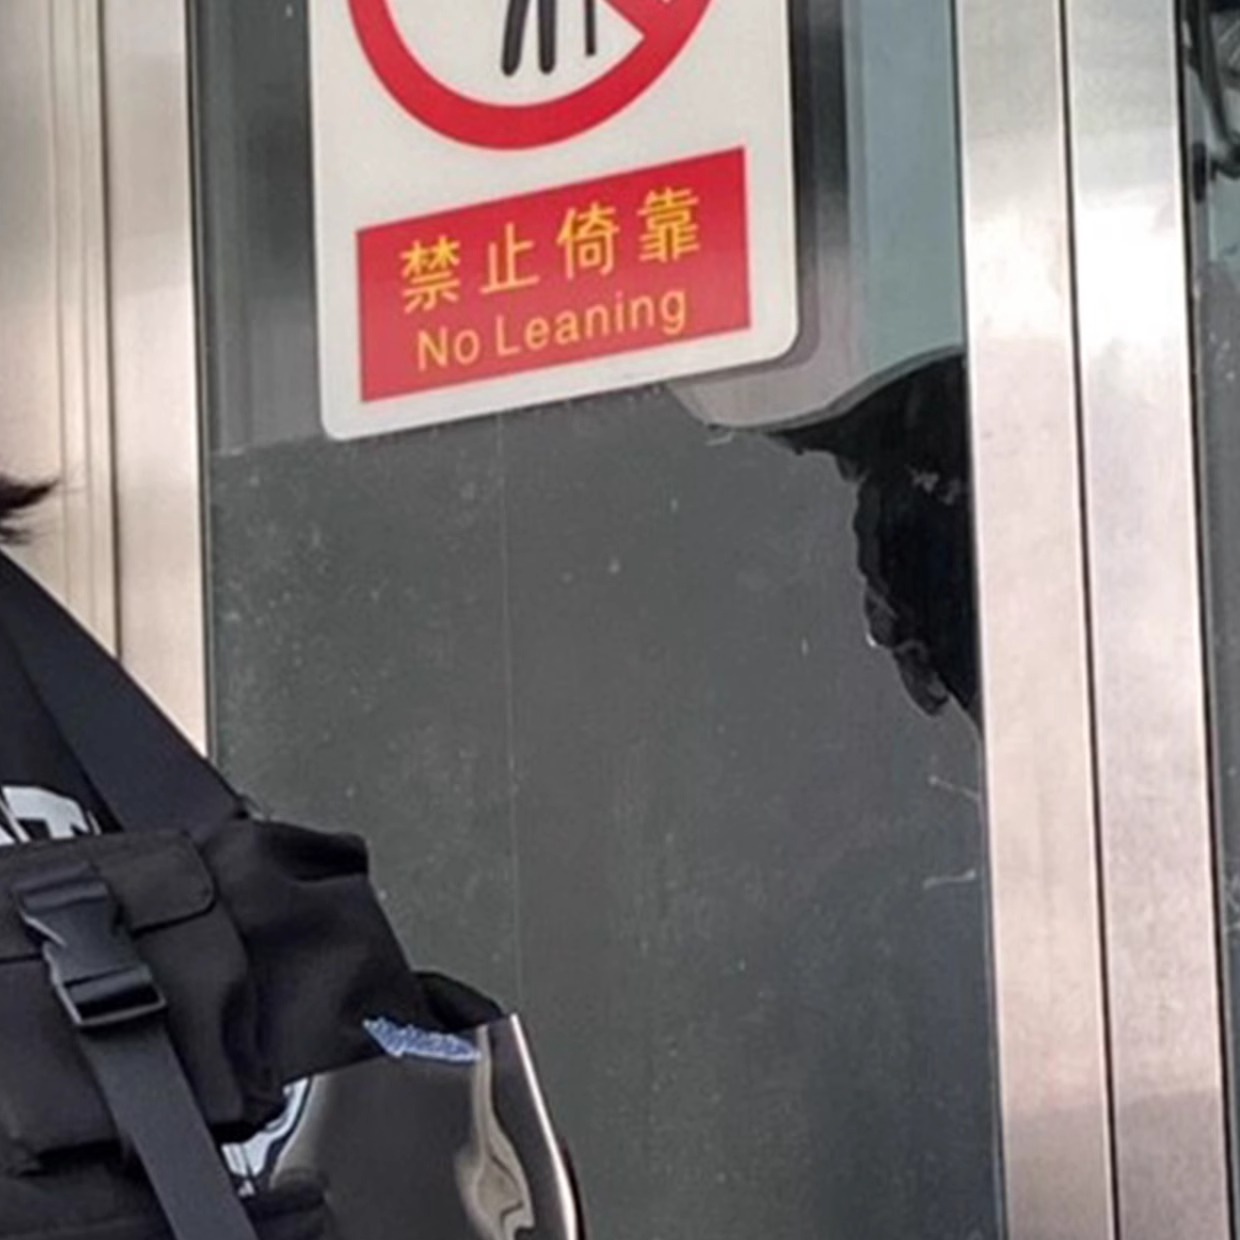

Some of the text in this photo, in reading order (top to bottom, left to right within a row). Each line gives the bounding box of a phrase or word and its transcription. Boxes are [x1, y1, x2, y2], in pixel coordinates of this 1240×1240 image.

[400, 187, 700, 313] 禁止倚靠
[417, 290, 687, 371] No Leaning
